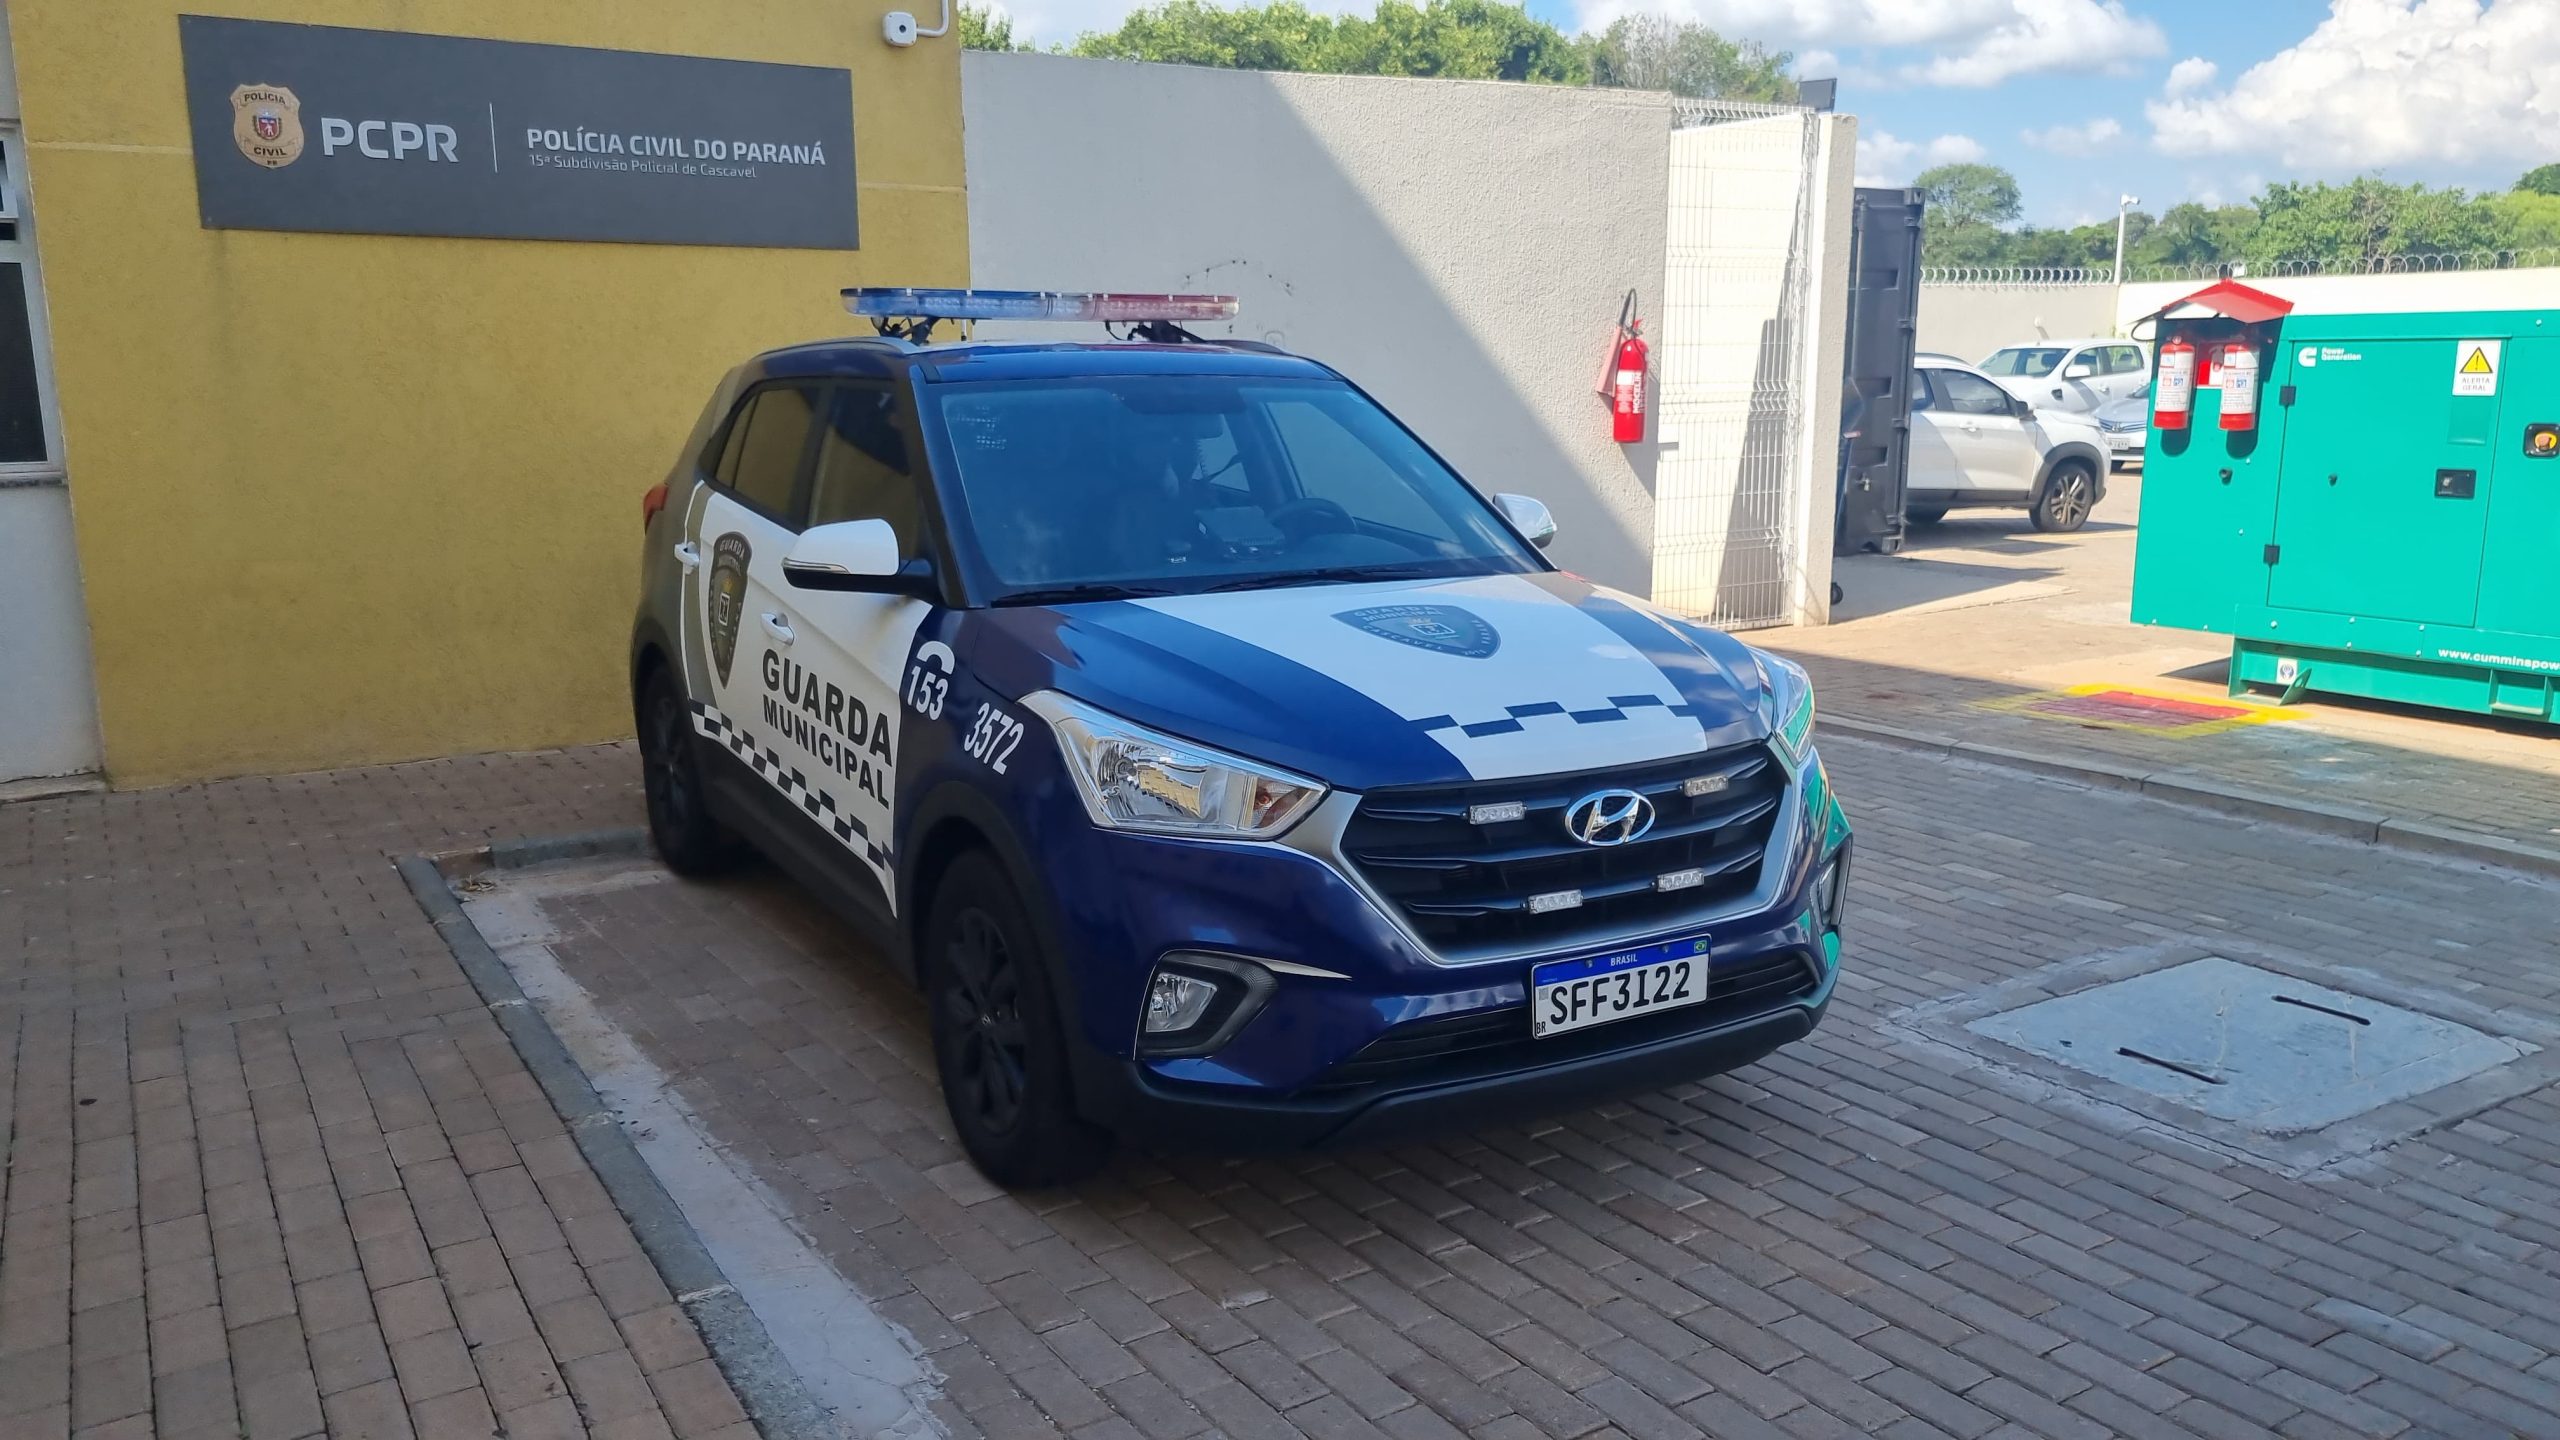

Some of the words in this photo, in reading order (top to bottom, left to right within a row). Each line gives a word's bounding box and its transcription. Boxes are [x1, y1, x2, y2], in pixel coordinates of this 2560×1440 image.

[253, 146, 288, 157] CIVIL
[320, 117, 460, 163] PCPR
[527, 126, 625, 155] POLÍCIA
[629, 135, 690, 158] CIVIL
[694, 139, 727, 161] DO
[732, 140, 826, 166] PARANÁ
[528, 154, 551, 167] 15ª
[554, 155, 628, 172] Subdivisão
[631, 159, 679, 174] Policial
[682, 162, 697, 175] de
[700, 163, 757, 178] Cascavel
[719, 539, 746, 560] GUARDA
[1353, 605, 1438, 617] GUARDA
[763, 648, 893, 767] GUARDA
[907, 665, 949, 720] 153
[762, 694, 890, 810] MUNICIPAL
[964, 702, 1025, 775] 3572
[1610, 953, 1638, 967] BRASIL
[1550, 961, 1691, 1025] SFF3I22
[1536, 1021, 1547, 1034] BR
